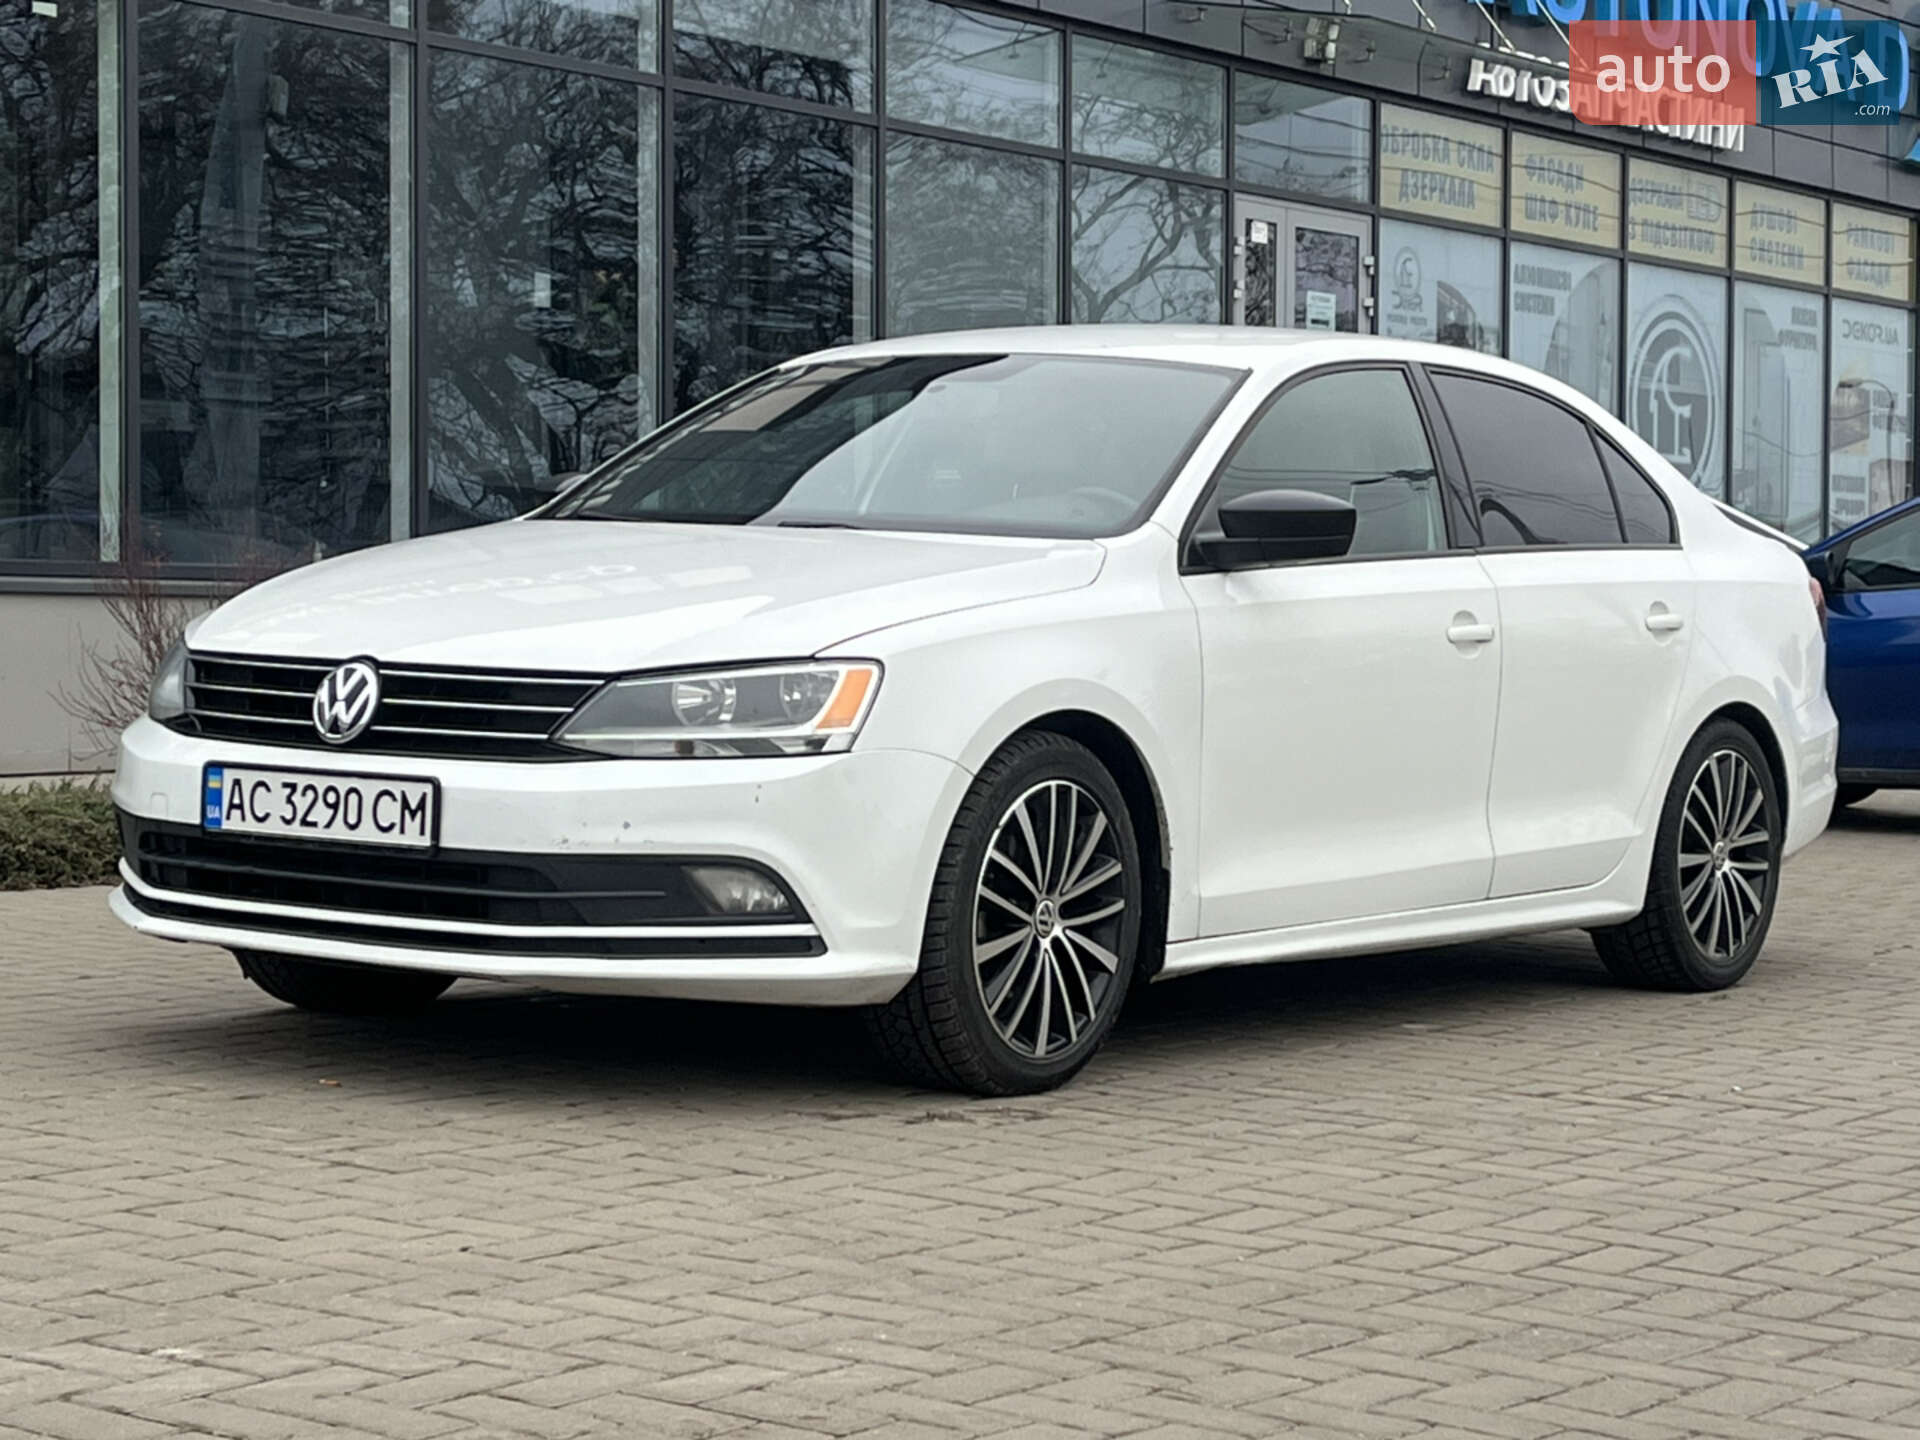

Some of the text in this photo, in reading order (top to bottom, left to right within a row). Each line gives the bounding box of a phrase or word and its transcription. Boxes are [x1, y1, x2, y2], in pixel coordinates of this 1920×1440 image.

[1526, 154, 1584, 194] ФАСАДИ
[1750, 236, 1805, 271] СИСТЕМИ
[206, 805, 221, 819] UA
[226, 778, 428, 836] AC 3290 CM
